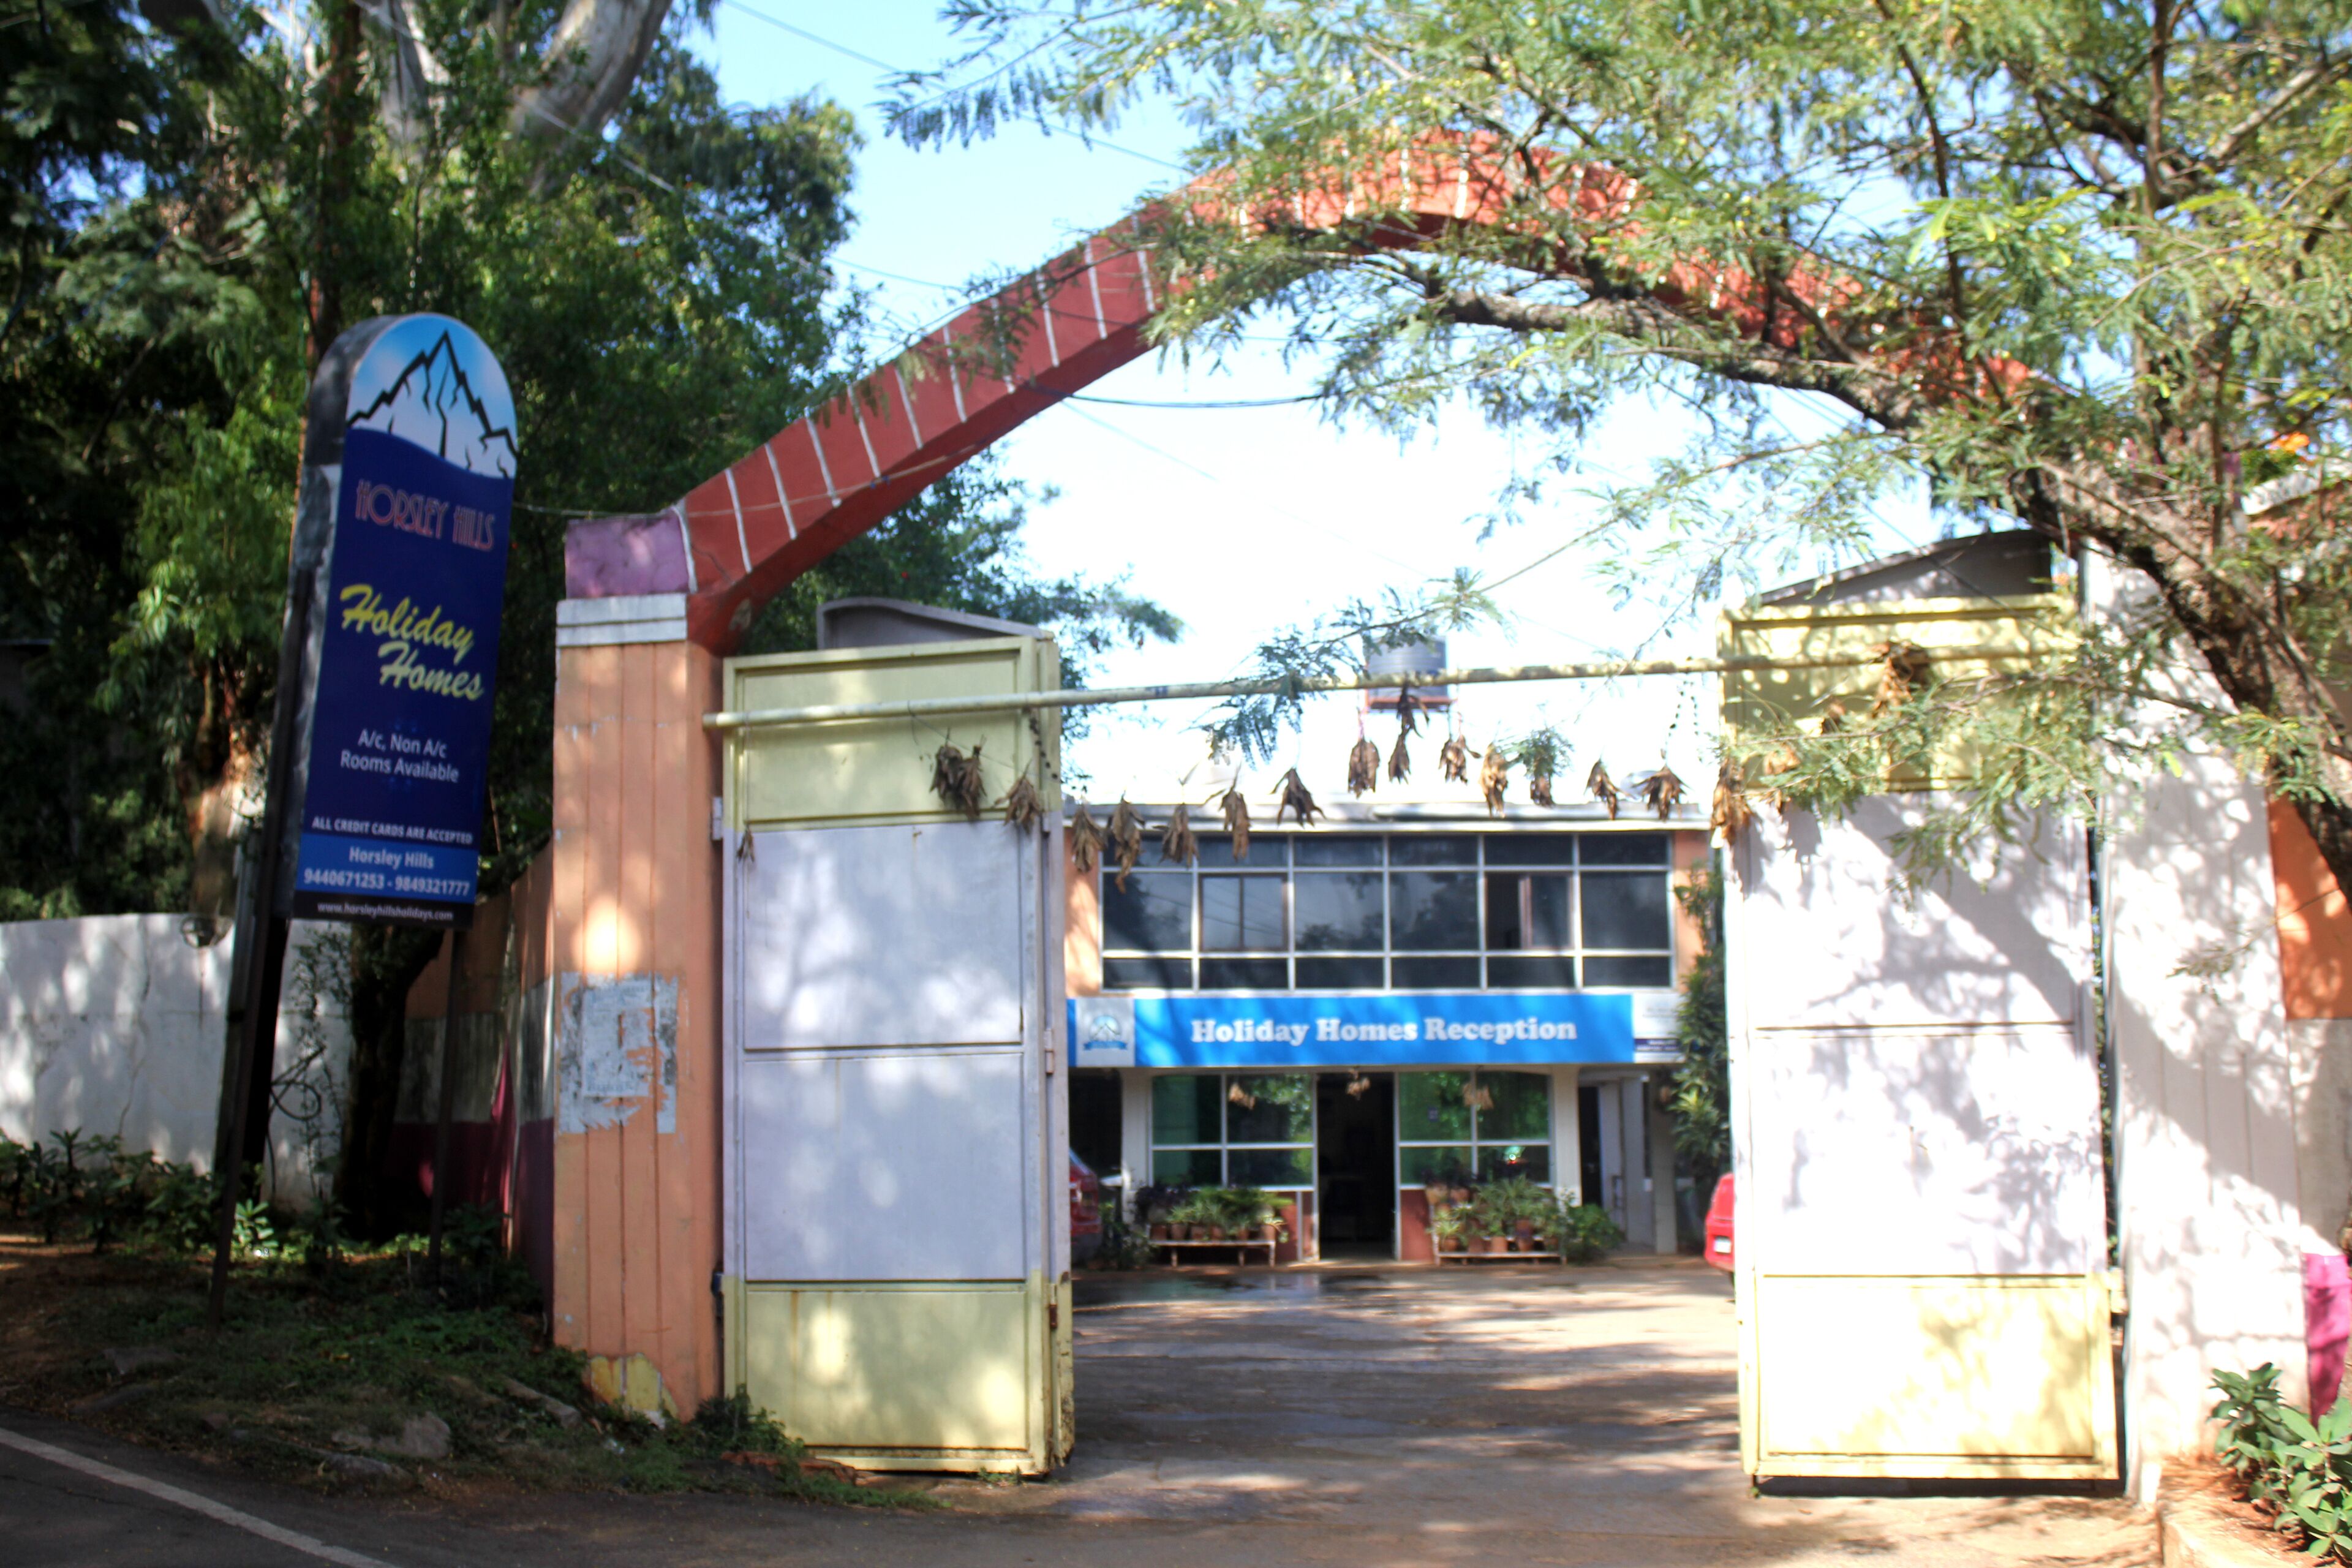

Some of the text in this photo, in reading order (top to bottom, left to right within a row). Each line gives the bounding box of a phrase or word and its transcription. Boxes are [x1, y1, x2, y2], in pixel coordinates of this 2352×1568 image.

[355, 480, 495, 551] HORSLEY HILLS
[340, 584, 474, 666] Holiday
[378, 641, 484, 701] Homes
[358, 728, 448, 759] A/c, Non A/c
[341, 749, 459, 783] Rooms Available
[312, 816, 473, 845] ALL CREDIT CARDS ARE ACCEPTED
[349, 846, 434, 870] Horsley Hills
[304, 867, 385, 890] 9440671253
[395, 876, 470, 896] 9849321777
[317, 902, 453, 922] www.horsleyhillsholidays.com
[1191, 1017, 1577, 1046] Holiday Homes Reception
